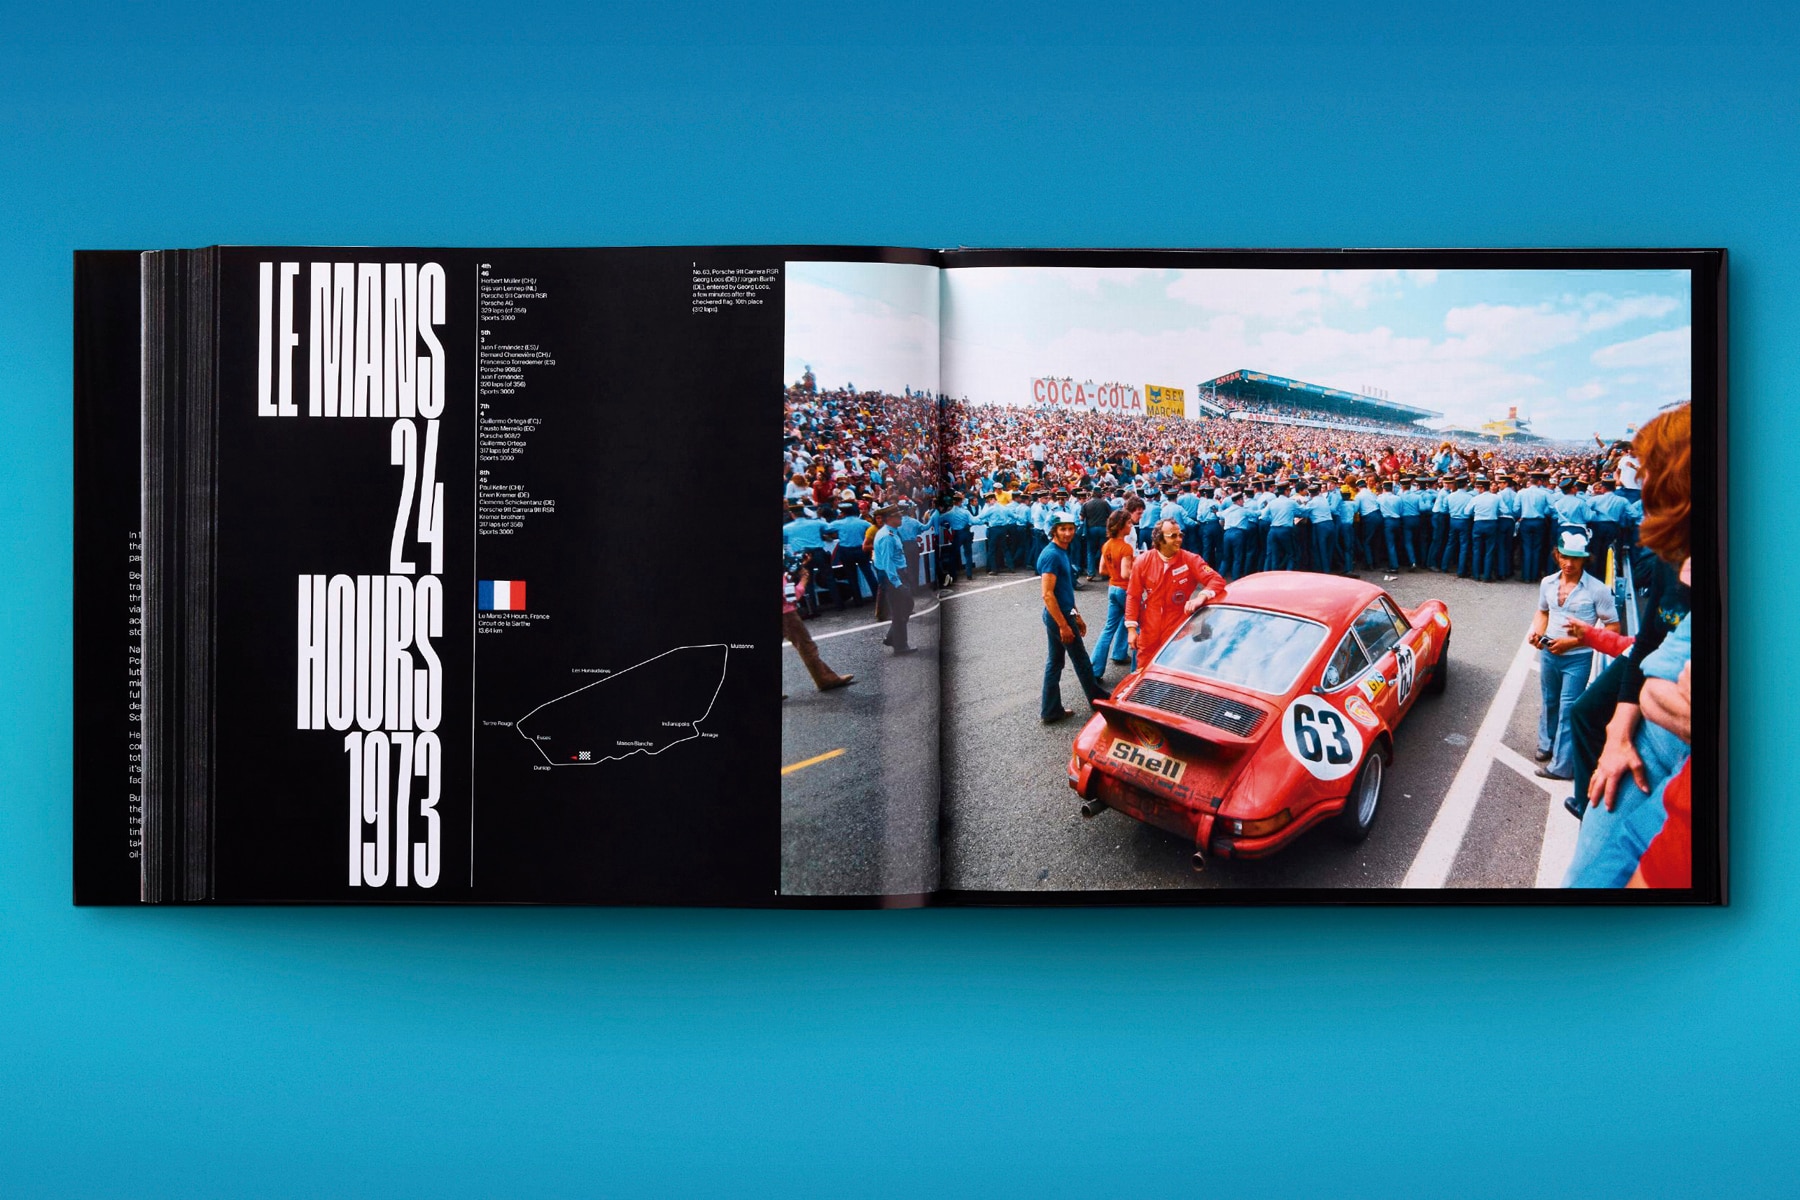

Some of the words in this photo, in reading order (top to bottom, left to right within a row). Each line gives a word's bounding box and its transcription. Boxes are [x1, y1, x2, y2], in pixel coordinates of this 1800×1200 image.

[258, 262, 299, 417] LE
[309, 262, 446, 420] MANS
[1034, 379, 1141, 410] COCA-COLA
[390, 419, 444, 574] 24
[297, 574, 443, 730] HOURS
[344, 732, 441, 888] 1973
[1112, 742, 1181, 779] Shell
[1294, 704, 1353, 764] 63
